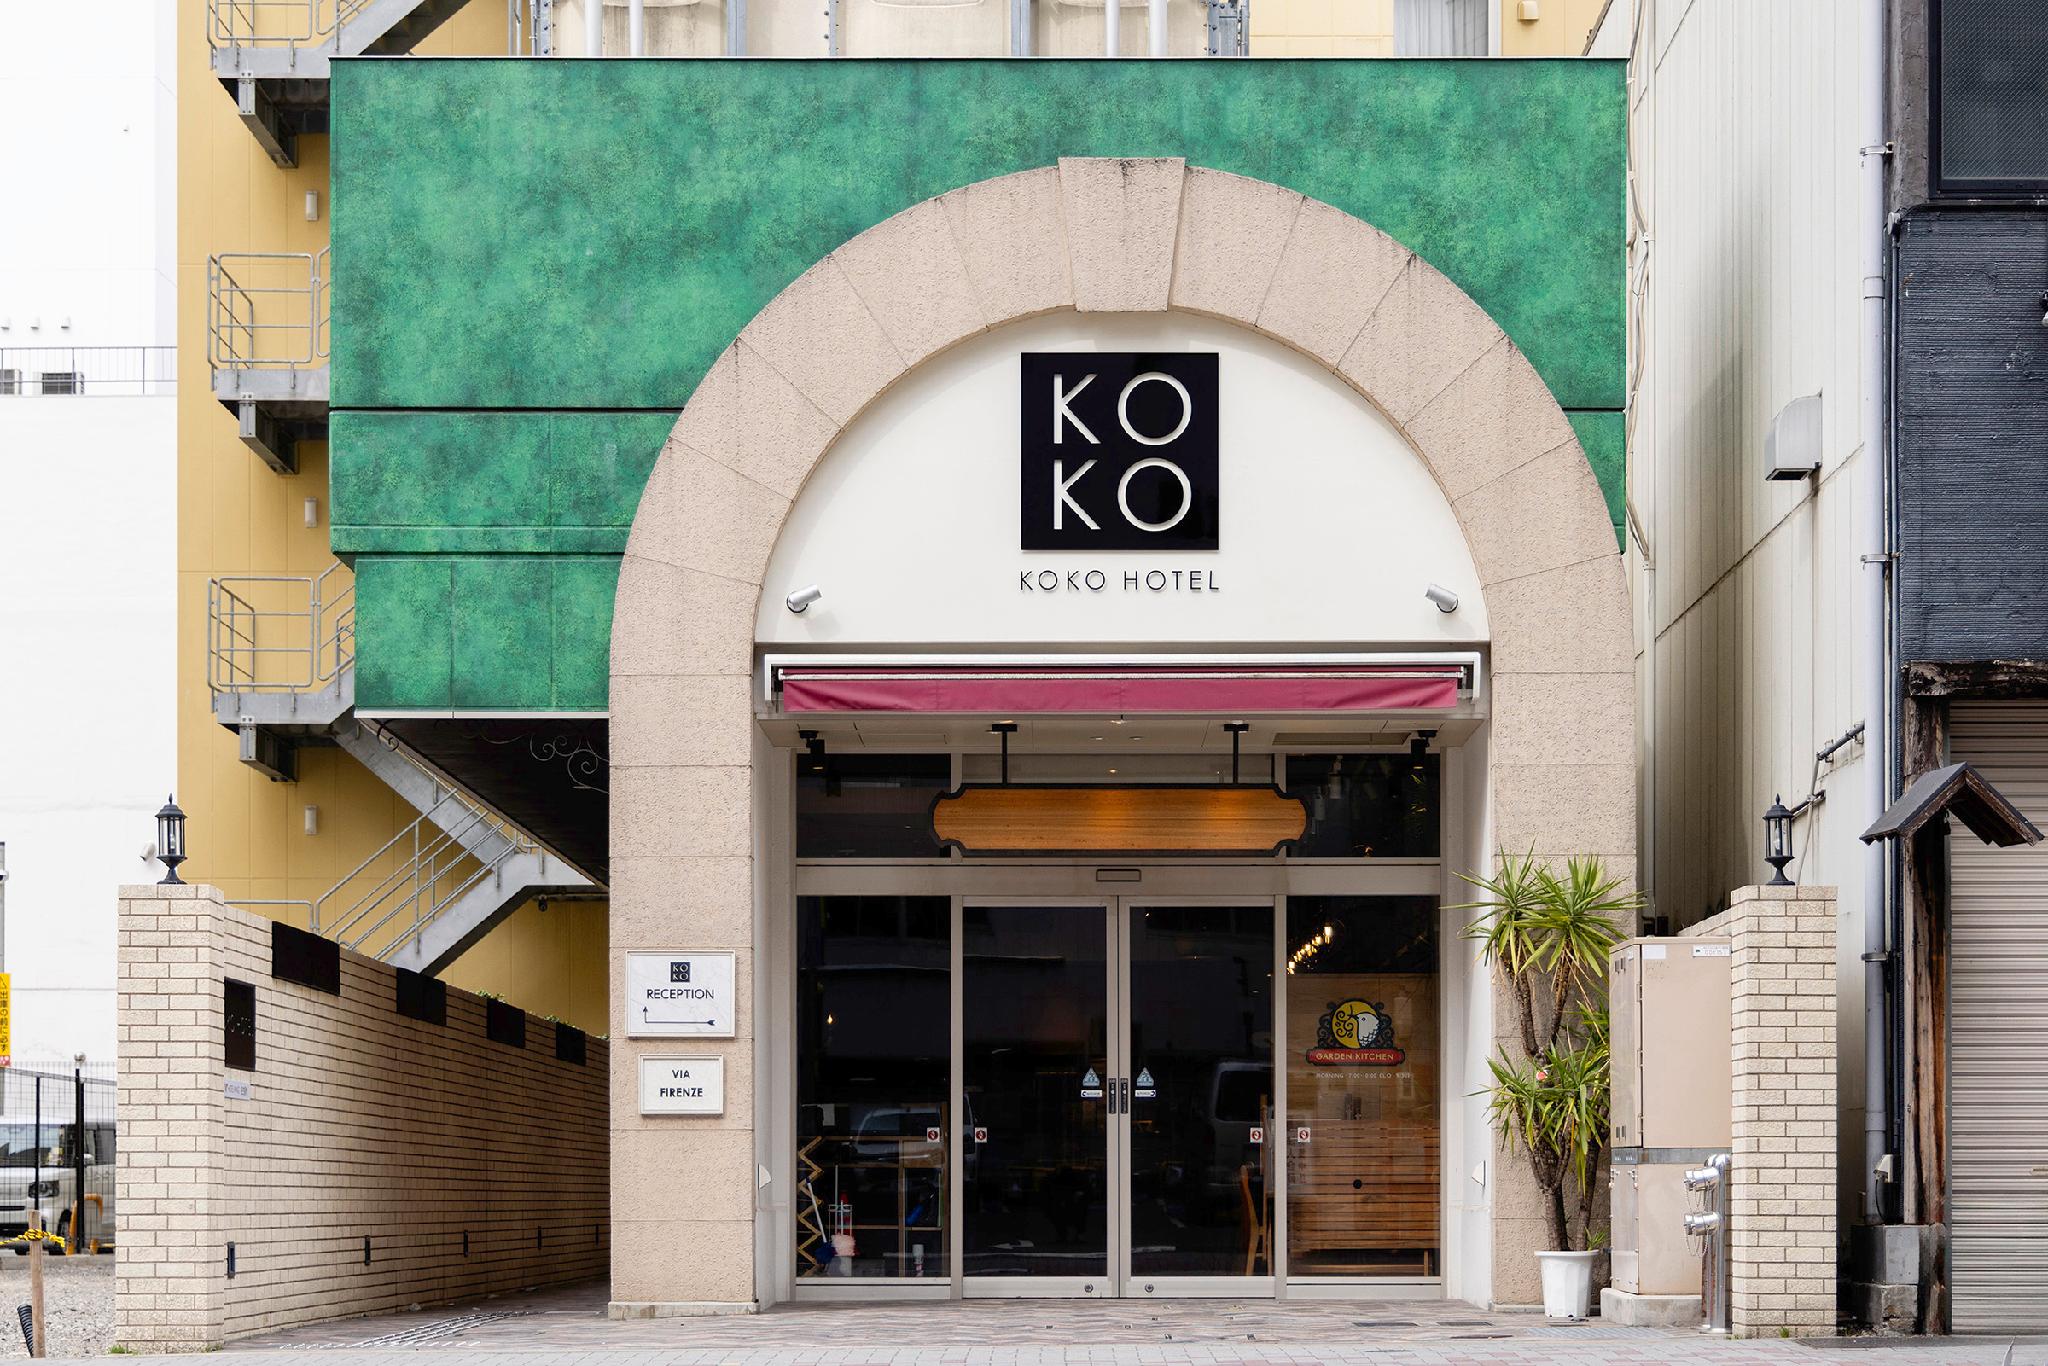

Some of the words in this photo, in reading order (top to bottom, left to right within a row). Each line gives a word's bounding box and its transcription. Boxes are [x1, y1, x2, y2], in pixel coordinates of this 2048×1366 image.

[1053, 371, 1192, 446] KO
[1053, 457, 1192, 532] KO
[1020, 570, 1106, 592] KOKO
[1123, 570, 1220, 592] HOTEL
[646, 989, 714, 1000] RECEPTION
[1315, 1052, 1353, 1061] GARDEN
[1355, 1052, 1394, 1061] KITCHEN
[671, 1069, 691, 1079] VIA
[659, 1087, 703, 1097] FIRENZE
